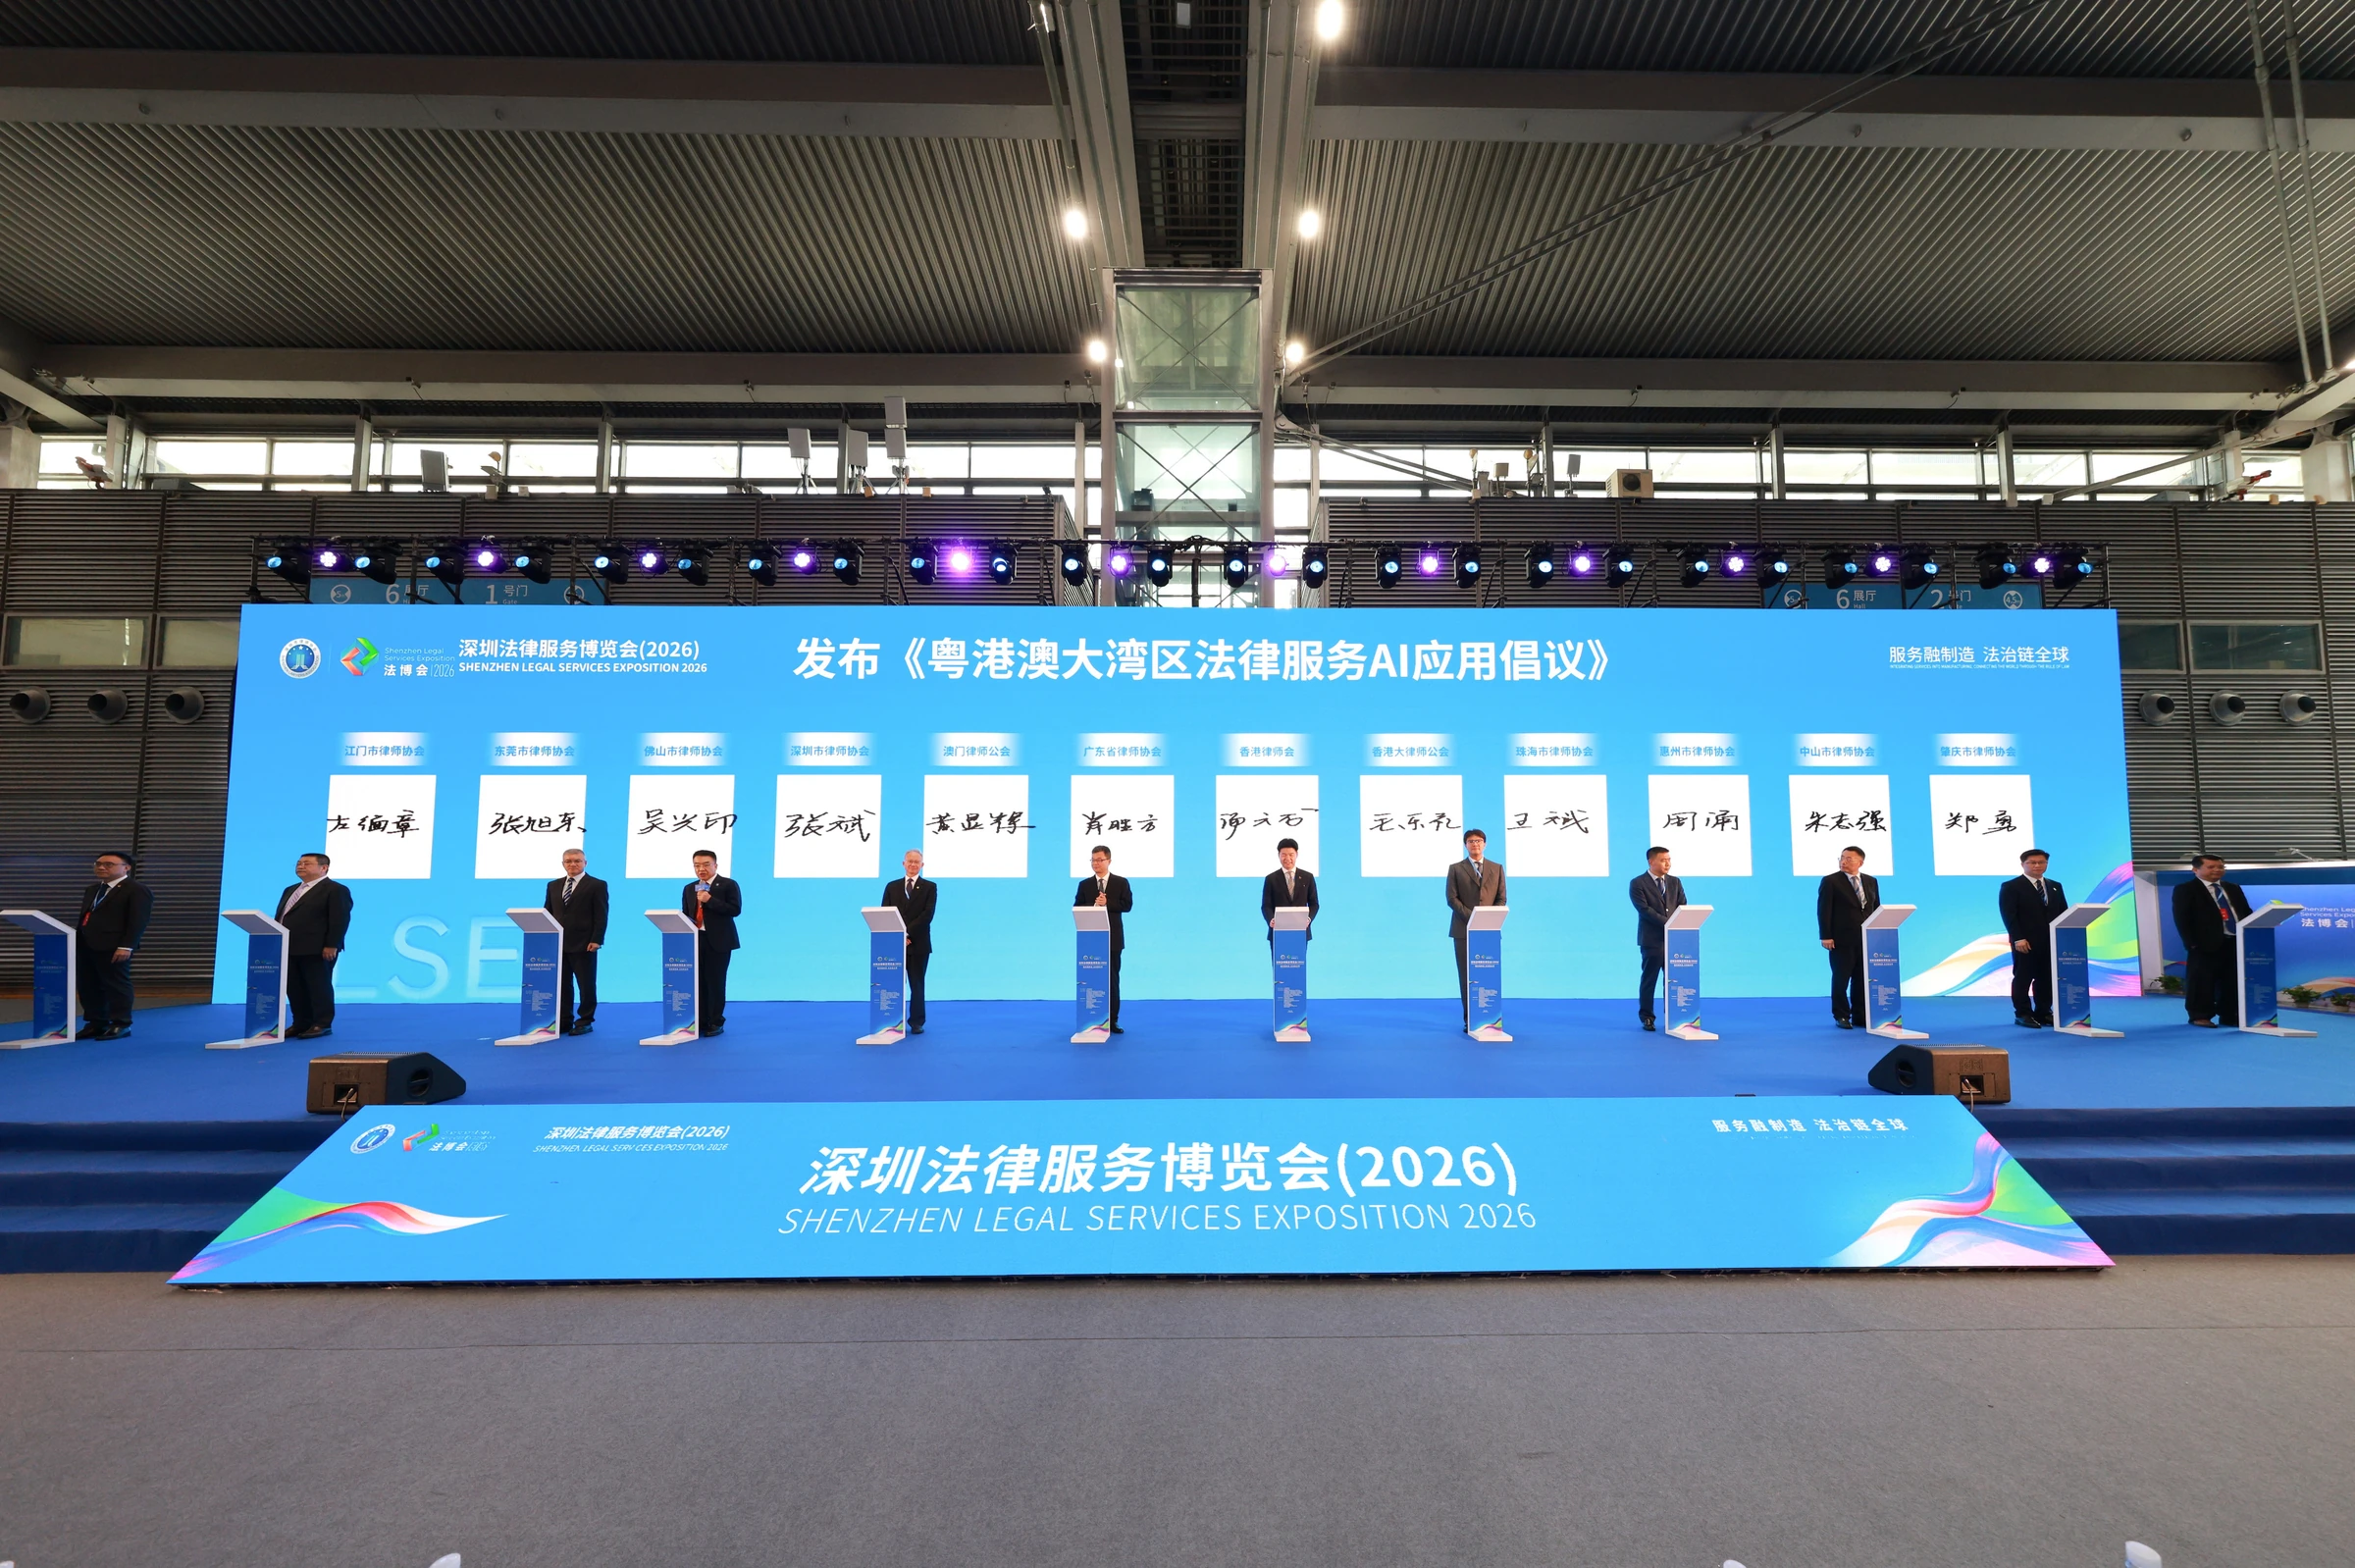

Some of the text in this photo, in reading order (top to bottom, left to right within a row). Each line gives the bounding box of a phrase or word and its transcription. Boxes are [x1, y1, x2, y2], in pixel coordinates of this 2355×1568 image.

[386, 584, 400, 604] 6
[486, 585, 528, 604] 1 号门
[1836, 589, 1876, 609] 6 展厅
[1930, 589, 1945, 609] 2
[458, 639, 700, 660] 深圳法律服务博览会(2026)
[1889, 647, 2069, 663] 服务融制造 法治链全球
[384, 664, 429, 676] 法博会
[458, 662, 707, 673] SHENZHEN LEGAL SERVICES EXPOSITION 2026
[345, 745, 425, 758] 江门市律师协会
[495, 745, 575, 758] 东莞市律师协会
[644, 745, 723, 758] 佛山市律师协会
[790, 745, 870, 758] 深圳市律师协会
[943, 746, 1011, 758] 澳门律师公会
[1083, 746, 1162, 758] 广东省律师协会
[1239, 746, 1294, 758] 香港律师会
[1372, 746, 1450, 758] 香港大律师公会
[1515, 746, 1594, 758] 珠海市律师协会
[1659, 746, 1736, 758] 惠州市律师协会
[1800, 746, 1875, 758] 中山市律师协会
[1940, 746, 2016, 758] 肇庆市律师协会
[2301, 918, 2349, 928] 法博会
[1712, 1118, 1909, 1132] 服务融制造 法治链全球
[545, 1125, 730, 1139] 深圳法律服务博览会(2026)
[799, 1141, 1517, 1197] 深圳法律服务博览会(2026)
[777, 1202, 1537, 1234] SHENZHEN LEGAL SERVICES EXPOSITION 2026
